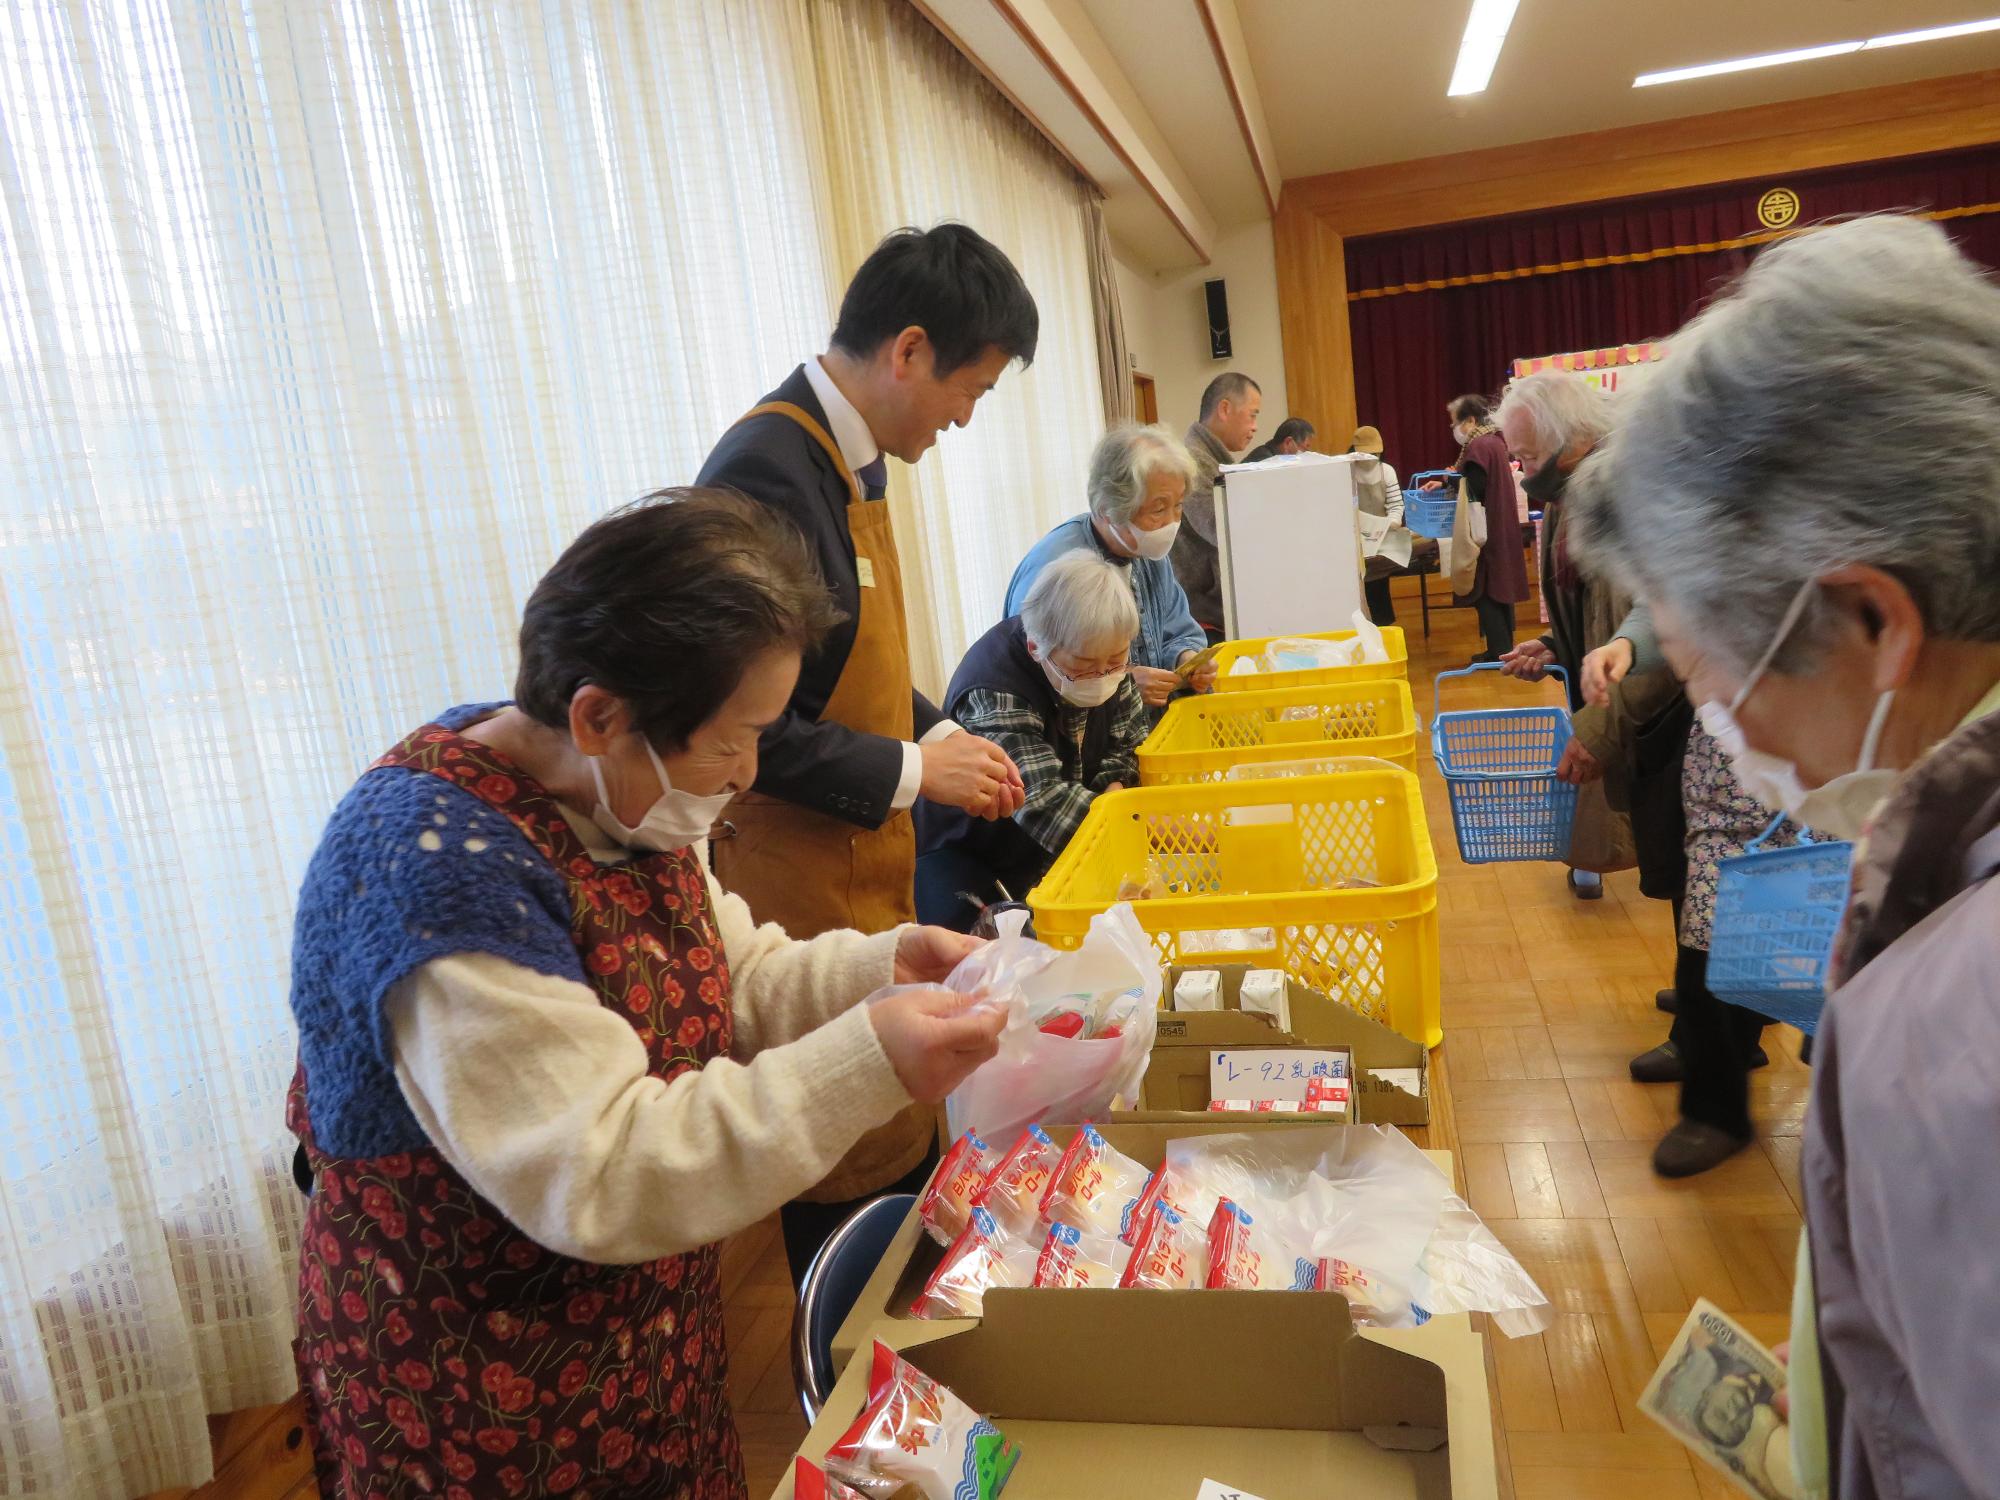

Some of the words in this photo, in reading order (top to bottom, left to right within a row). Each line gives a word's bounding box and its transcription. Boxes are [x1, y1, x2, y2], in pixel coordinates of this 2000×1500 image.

[1024, 1163, 1049, 1194] ロール
[1081, 1169, 1102, 1200] ロール
